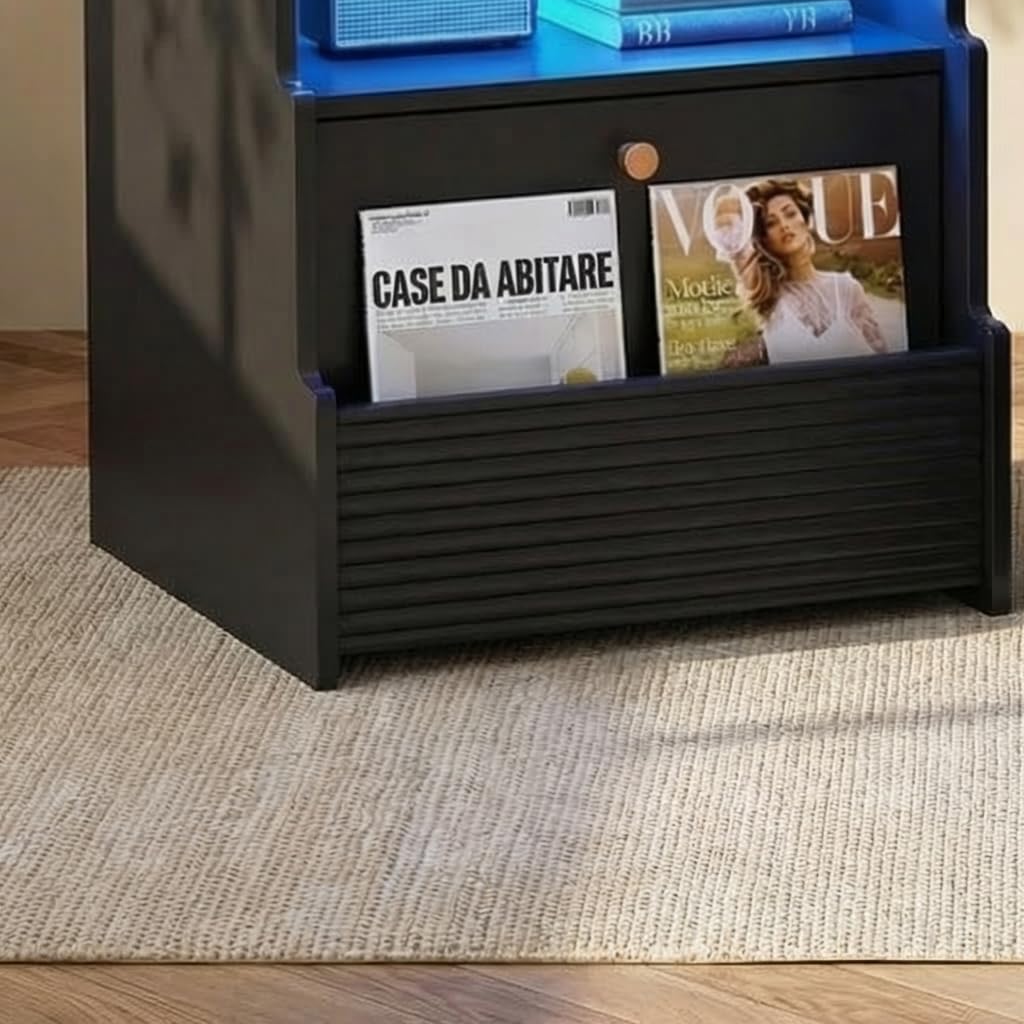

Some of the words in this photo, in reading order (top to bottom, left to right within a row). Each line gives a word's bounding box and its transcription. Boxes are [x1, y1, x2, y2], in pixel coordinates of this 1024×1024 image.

[658, 171, 901, 258] VOUE
[372, 265, 447, 309] CASE
[450, 261, 491, 302] DA
[496, 250, 614, 298] ABITARE
